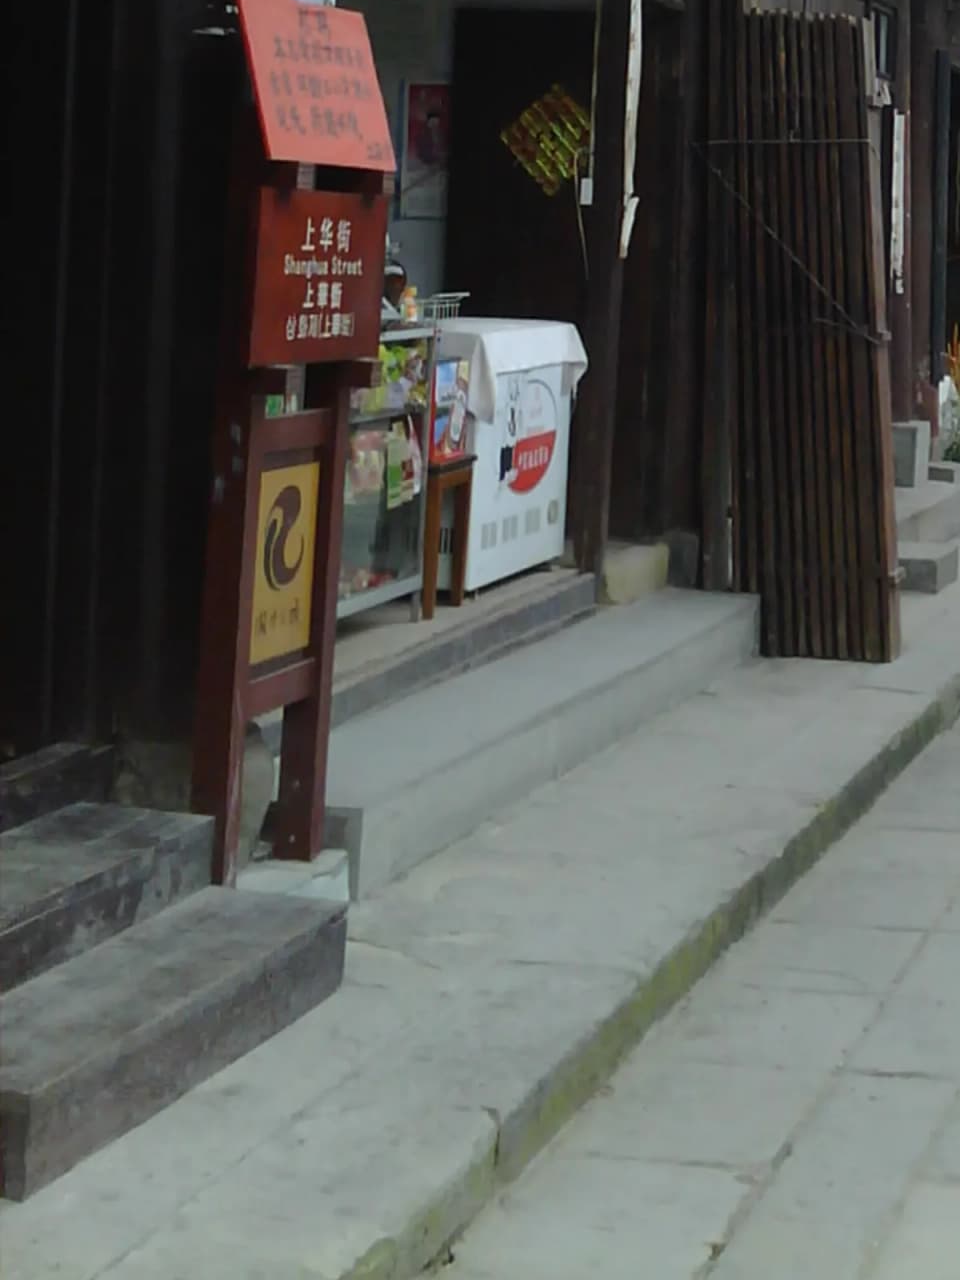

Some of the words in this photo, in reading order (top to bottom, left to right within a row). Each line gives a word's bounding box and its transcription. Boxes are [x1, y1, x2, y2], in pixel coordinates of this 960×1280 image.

[301, 217, 351, 253] 上华街
[284, 253, 328, 279] Shanghua
[331, 255, 363, 276] Street
